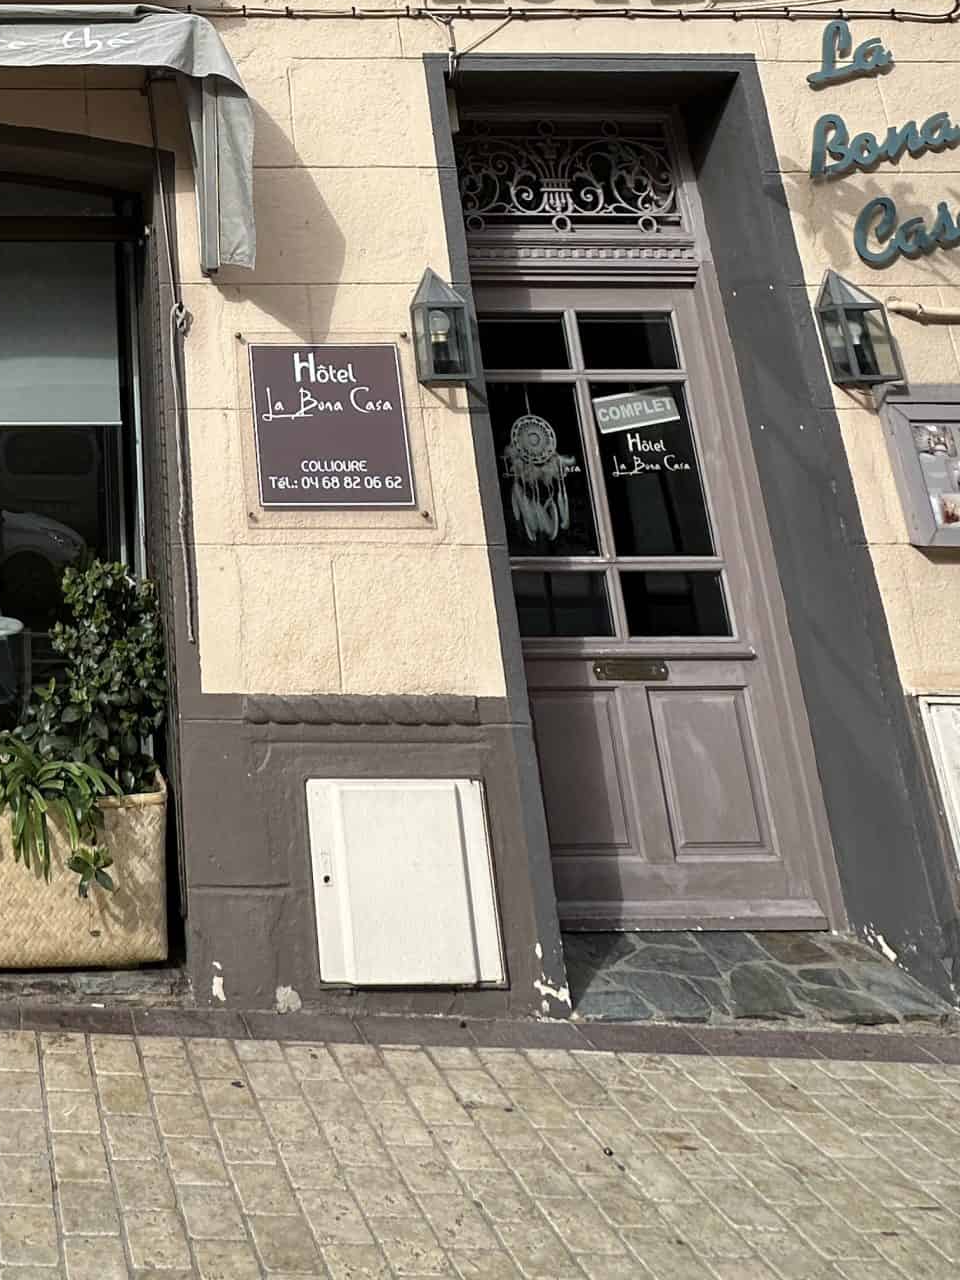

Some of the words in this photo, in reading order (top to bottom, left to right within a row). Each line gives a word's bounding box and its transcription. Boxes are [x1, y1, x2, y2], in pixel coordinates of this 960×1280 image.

[806, 20, 895, 90] La
[809, 112, 960, 180] Bona
[853, 197, 960, 270] Cas
[293, 352, 357, 383] Hôtel
[262, 387, 285, 421] La
[290, 387, 344, 420] Bona
[350, 387, 393, 413] Casa
[597, 397, 672, 423] COMPLET
[626, 433, 667, 452] Hôtel
[300, 460, 368, 472] COLLIOURE
[301, 476, 320, 489] 04
[322, 476, 341, 489] 68
[343, 476, 362, 489] 82
[364, 476, 382, 489] 06
[385, 476, 402, 489] 62
